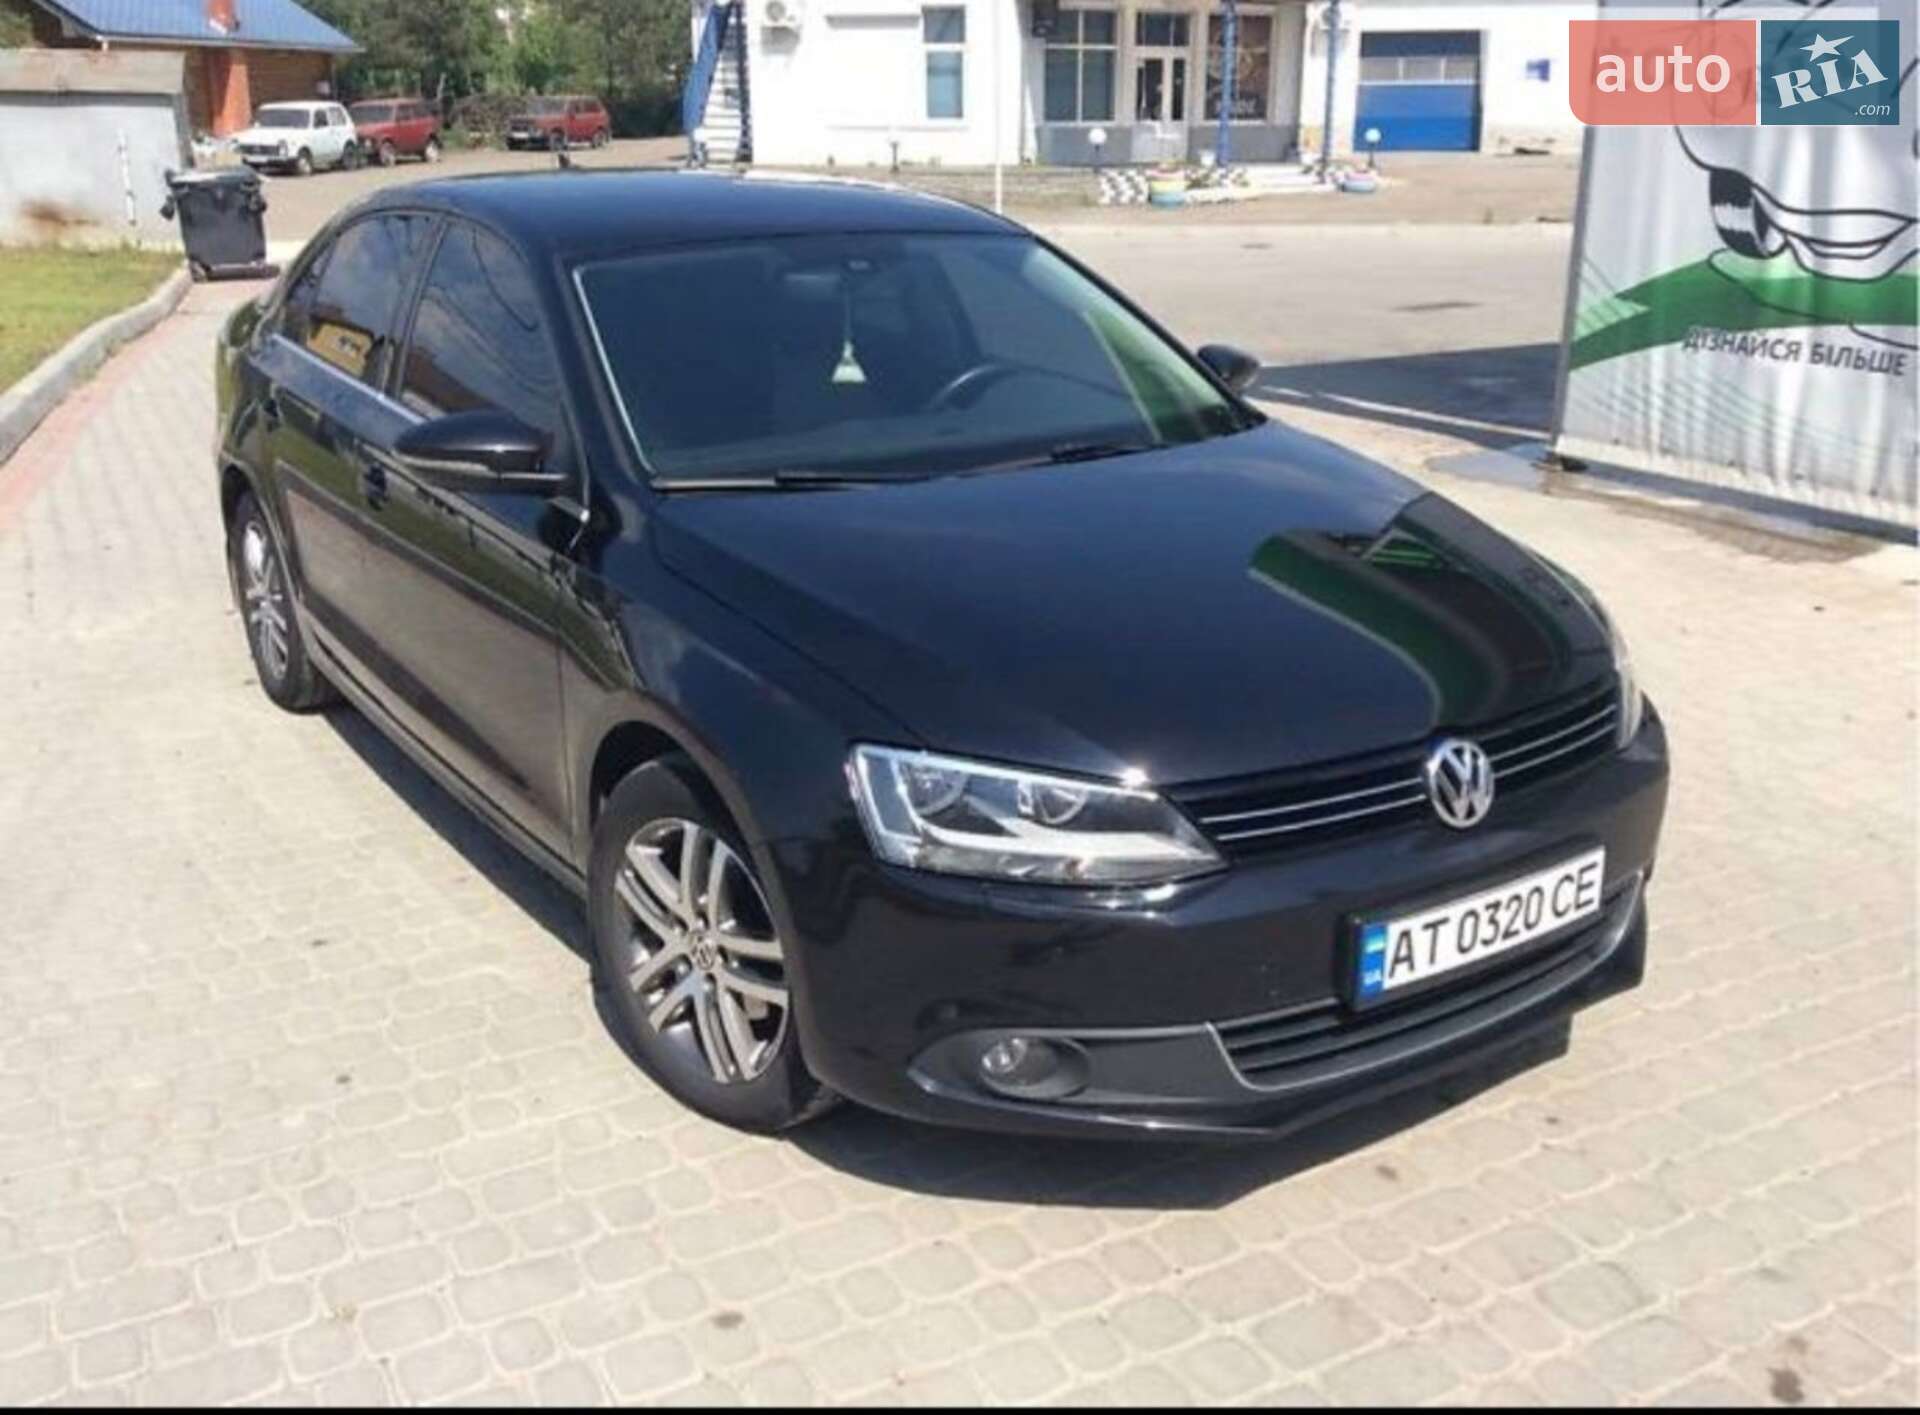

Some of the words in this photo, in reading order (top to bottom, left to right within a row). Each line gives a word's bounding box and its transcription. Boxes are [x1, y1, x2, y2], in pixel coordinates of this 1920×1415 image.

[1808, 343, 1909, 377] БІЛЬШЕ
[1388, 917, 1450, 980] AT
[1456, 885, 1545, 955] 0320
[1551, 861, 1599, 918] CE
